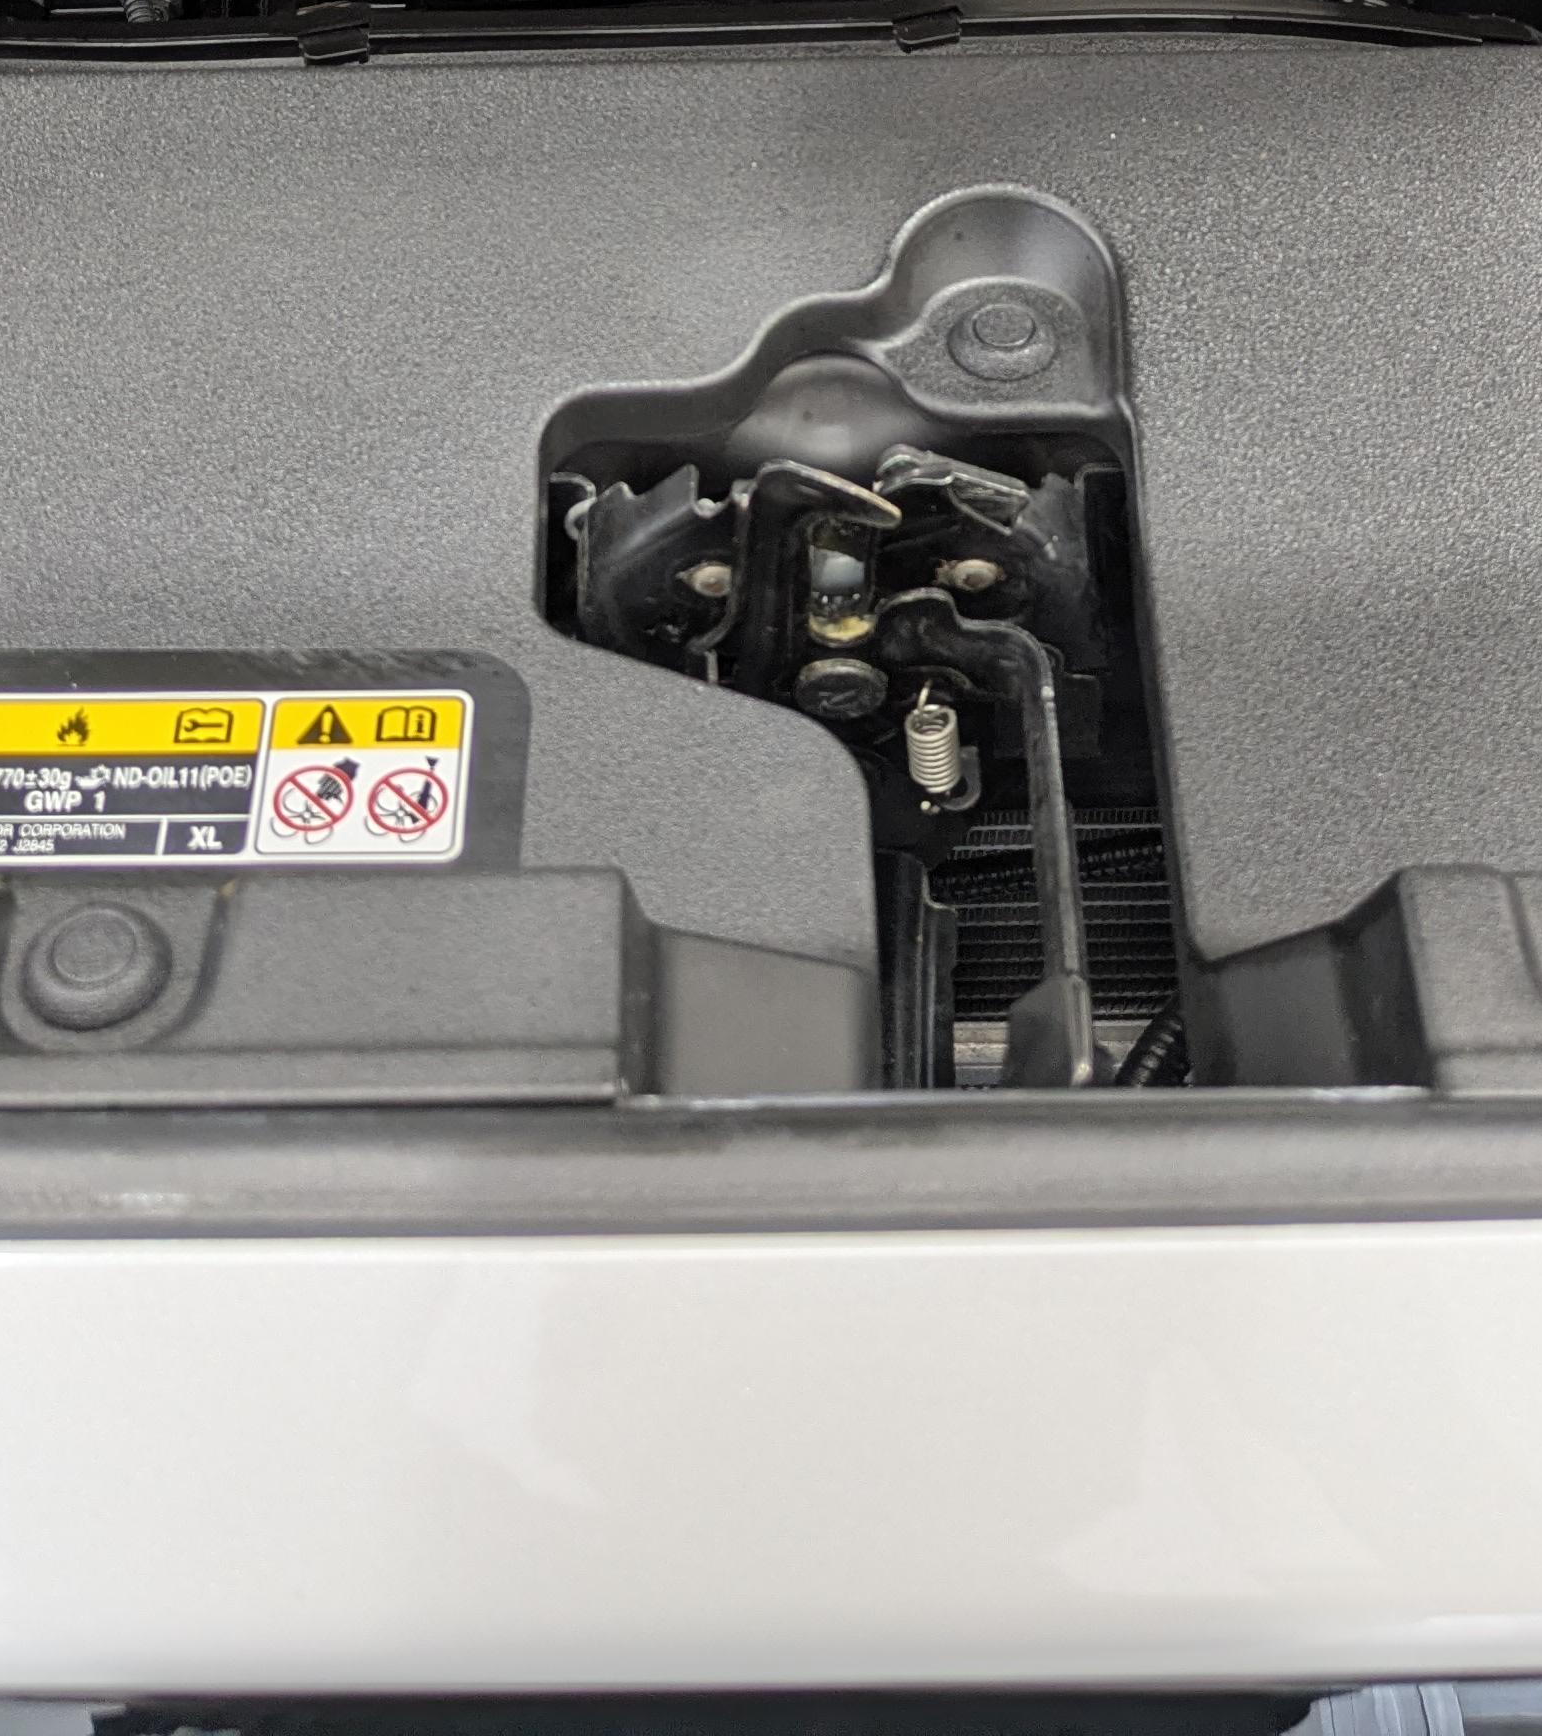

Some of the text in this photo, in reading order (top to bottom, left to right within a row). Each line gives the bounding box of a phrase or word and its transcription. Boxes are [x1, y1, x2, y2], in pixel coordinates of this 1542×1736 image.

[111, 763, 253, 791] ND-OIL11(POE)
[23, 790, 107, 813] GWP 1
[18, 822, 128, 840] CORPORATION
[186, 825, 223, 852] XL
[12, 838, 56, 855] J2845
